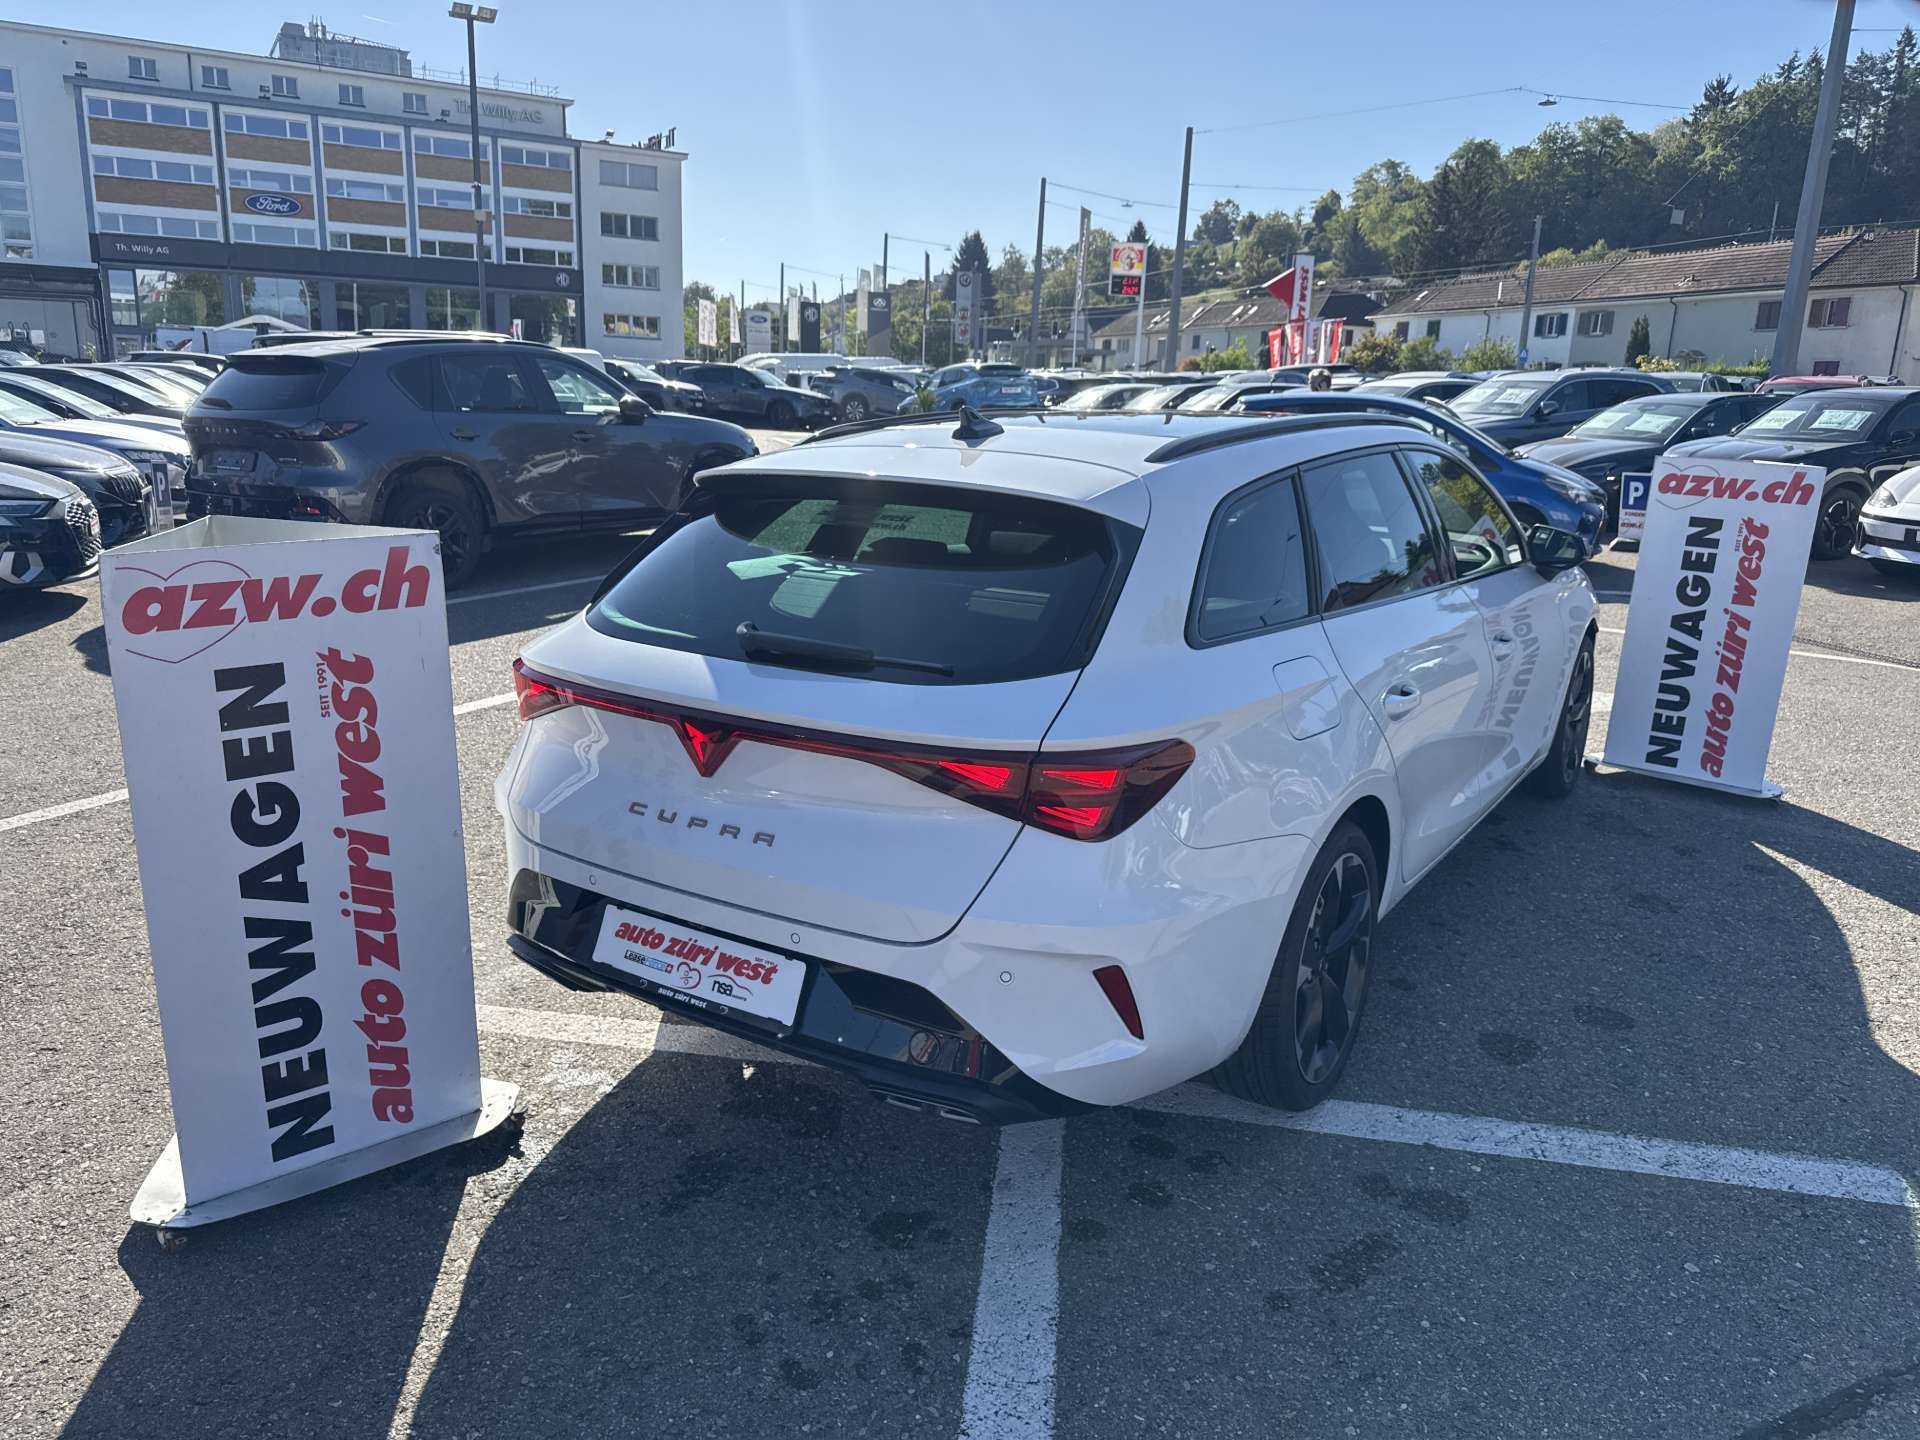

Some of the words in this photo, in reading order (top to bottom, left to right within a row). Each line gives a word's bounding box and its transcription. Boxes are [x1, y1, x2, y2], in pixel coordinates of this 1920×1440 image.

[481, 102, 514, 121] Willy
[115, 243, 128, 252] Th.
[132, 244, 153, 255] Willy
[156, 246, 169, 255] AG
[157, 472, 166, 501] P
[1628, 481, 1645, 505] P
[1658, 471, 1815, 506] azw.ch
[1731, 516, 1770, 607] west
[122, 546, 431, 635] azw.ch
[1645, 516, 1724, 768] NEUWAGEN
[1715, 607, 1751, 694] züri
[316, 662, 328, 691] 1991
[316, 646, 386, 816] west
[320, 694, 331, 719] SEIT
[1700, 692, 1735, 778] auto
[628, 801, 776, 848] CUPRA
[214, 662, 335, 1163] NEUWAGEN
[333, 827, 401, 971] züri
[614, 922, 666, 950] auto
[662, 936, 719, 966] züri
[715, 951, 779, 985] west
[657, 987, 675, 998] auto
[690, 996, 707, 1009] west
[711, 979, 733, 997] nsa
[353, 978, 414, 1124] auto
